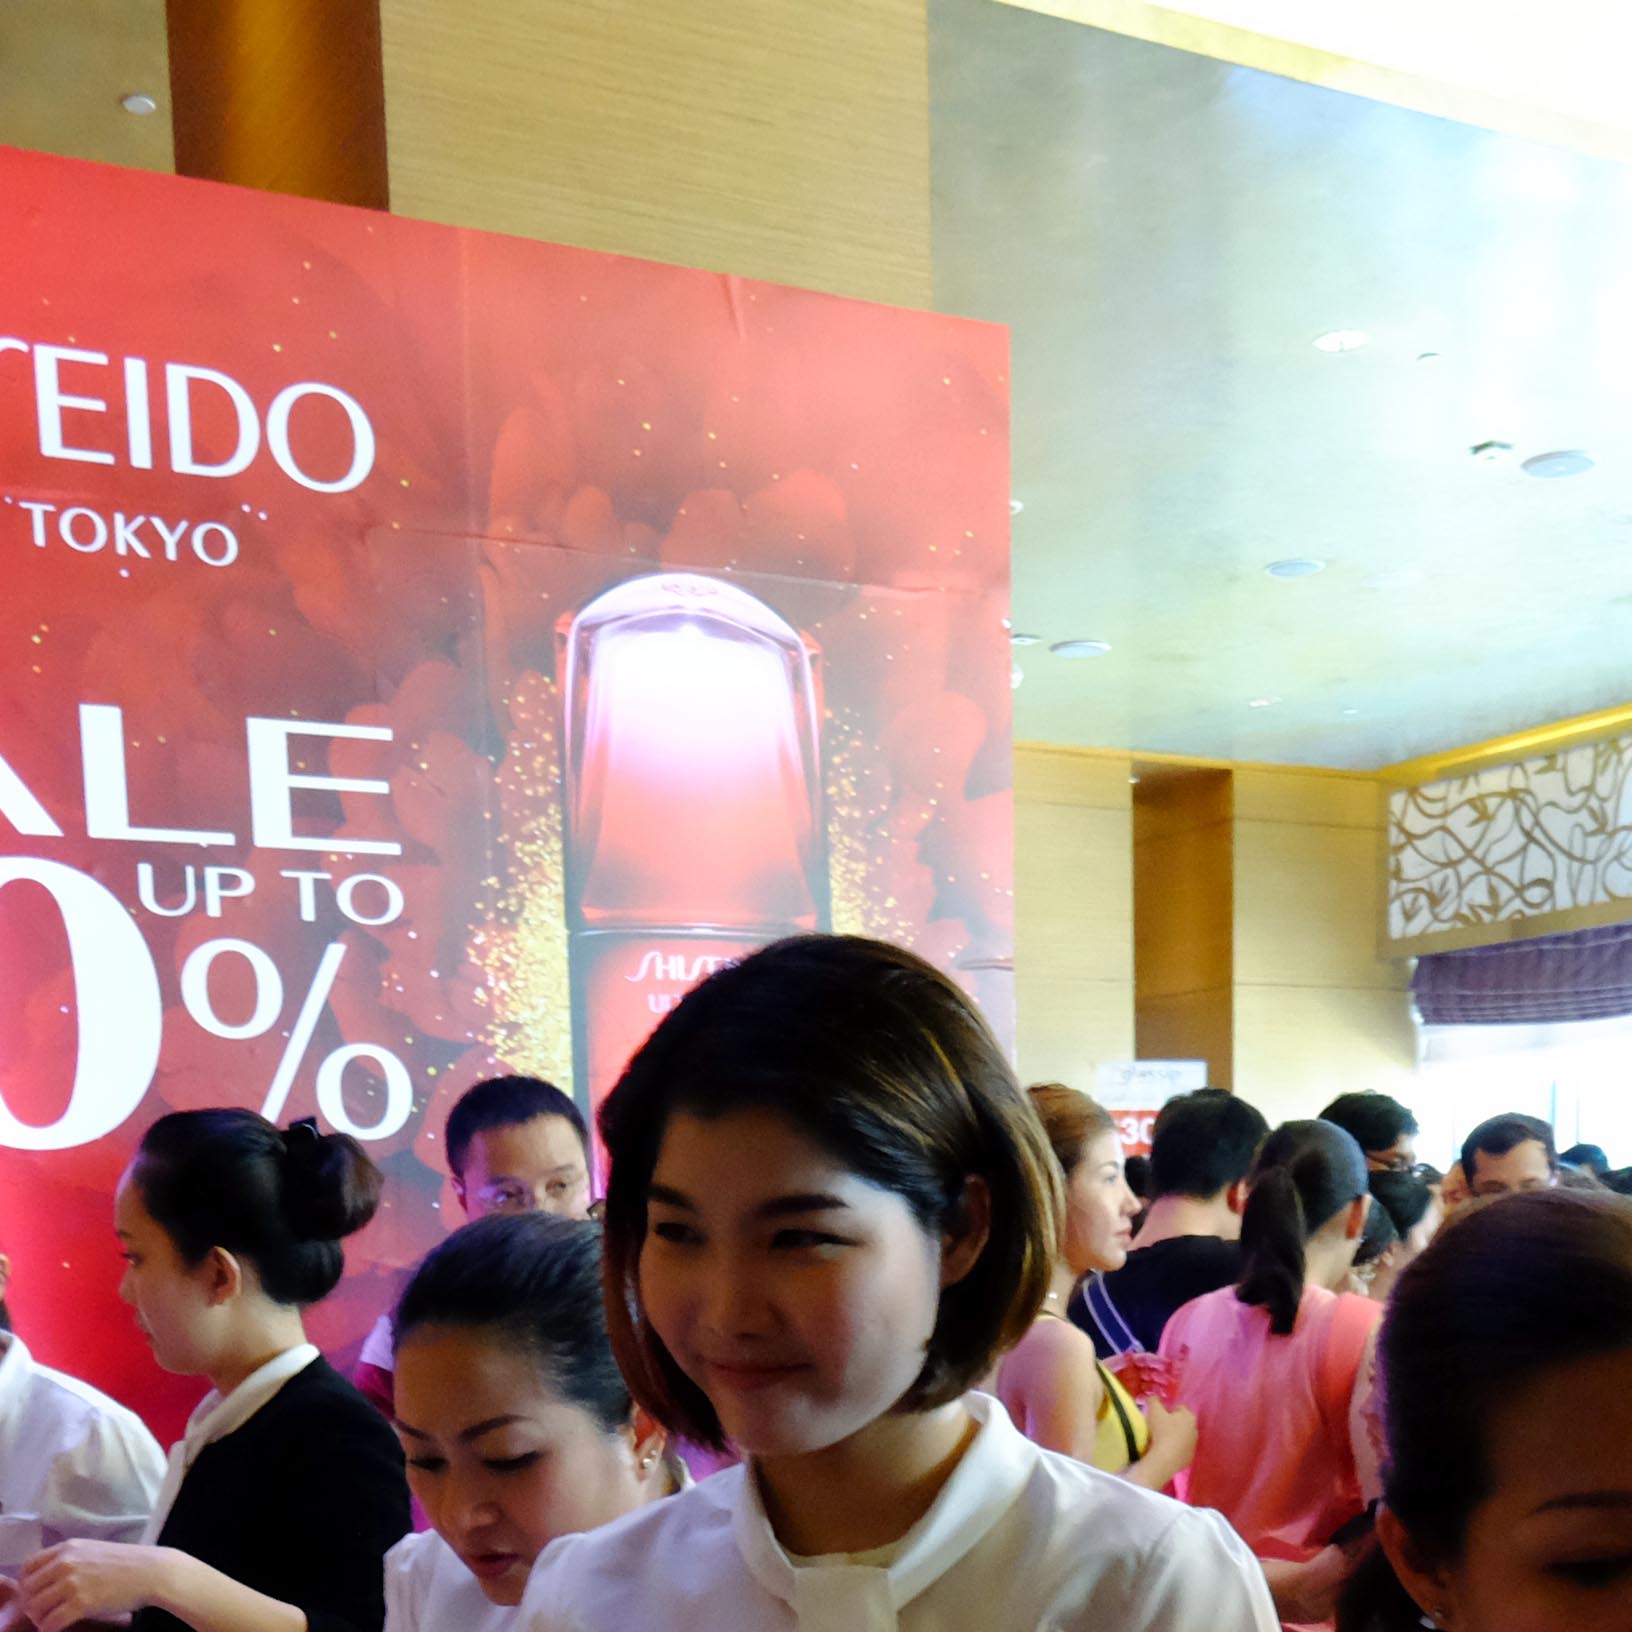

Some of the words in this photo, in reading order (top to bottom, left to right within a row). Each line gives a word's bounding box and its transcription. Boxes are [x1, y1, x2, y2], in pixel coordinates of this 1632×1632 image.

[18, 501, 240, 568] TOKYO
[137, 862, 256, 919] UP
[280, 869, 405, 926] TO
